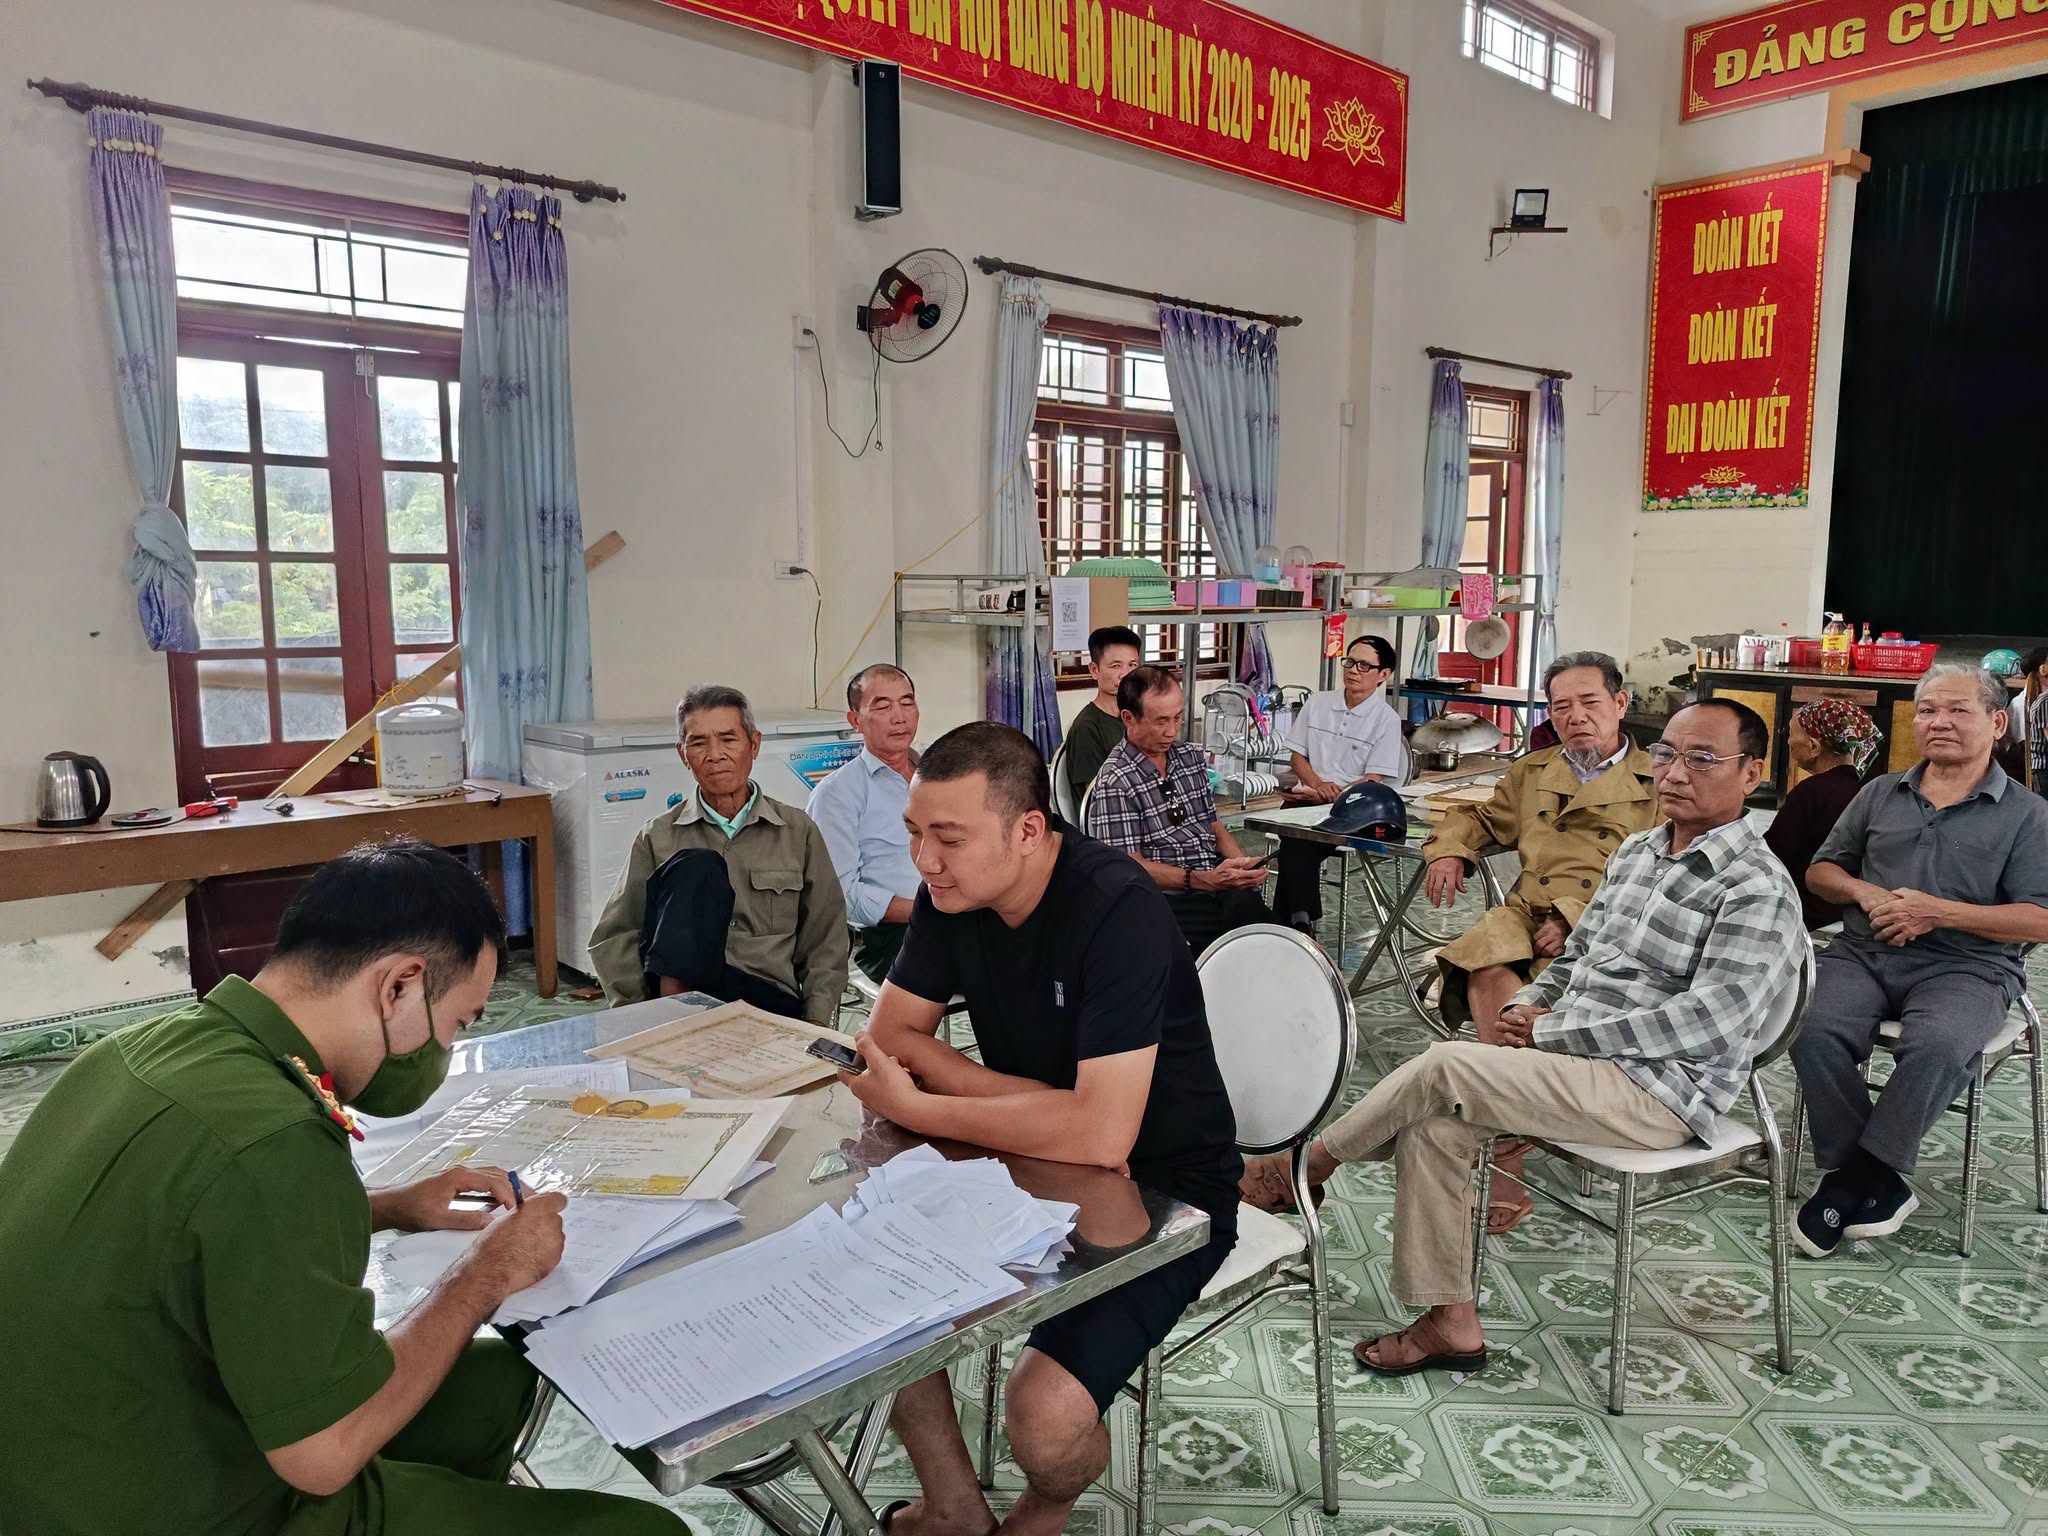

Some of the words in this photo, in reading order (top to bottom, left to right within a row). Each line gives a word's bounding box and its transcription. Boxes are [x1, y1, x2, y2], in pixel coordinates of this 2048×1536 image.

[1110, 4, 1174, 130] NHIỆM
[1178, 23, 1204, 127] KỲ
[1207, 43, 1254, 144] 2020
[1257, 104, 1265, 121] -
[1268, 66, 1312, 162] 2025
[1713, 17, 1867, 89] ĐẢNG
[1692, 209, 1744, 276] ĐOÀN
[1746, 191, 1784, 268] KẾT
[1687, 301, 1738, 366] ĐOÀN
[1741, 286, 1778, 360] KẾT
[1665, 402, 1697, 464] ĐẠI
[1700, 391, 1751, 453] ĐOÀN
[1753, 377, 1791, 450] KẾT
[614, 768, 651, 779] ALASKA
